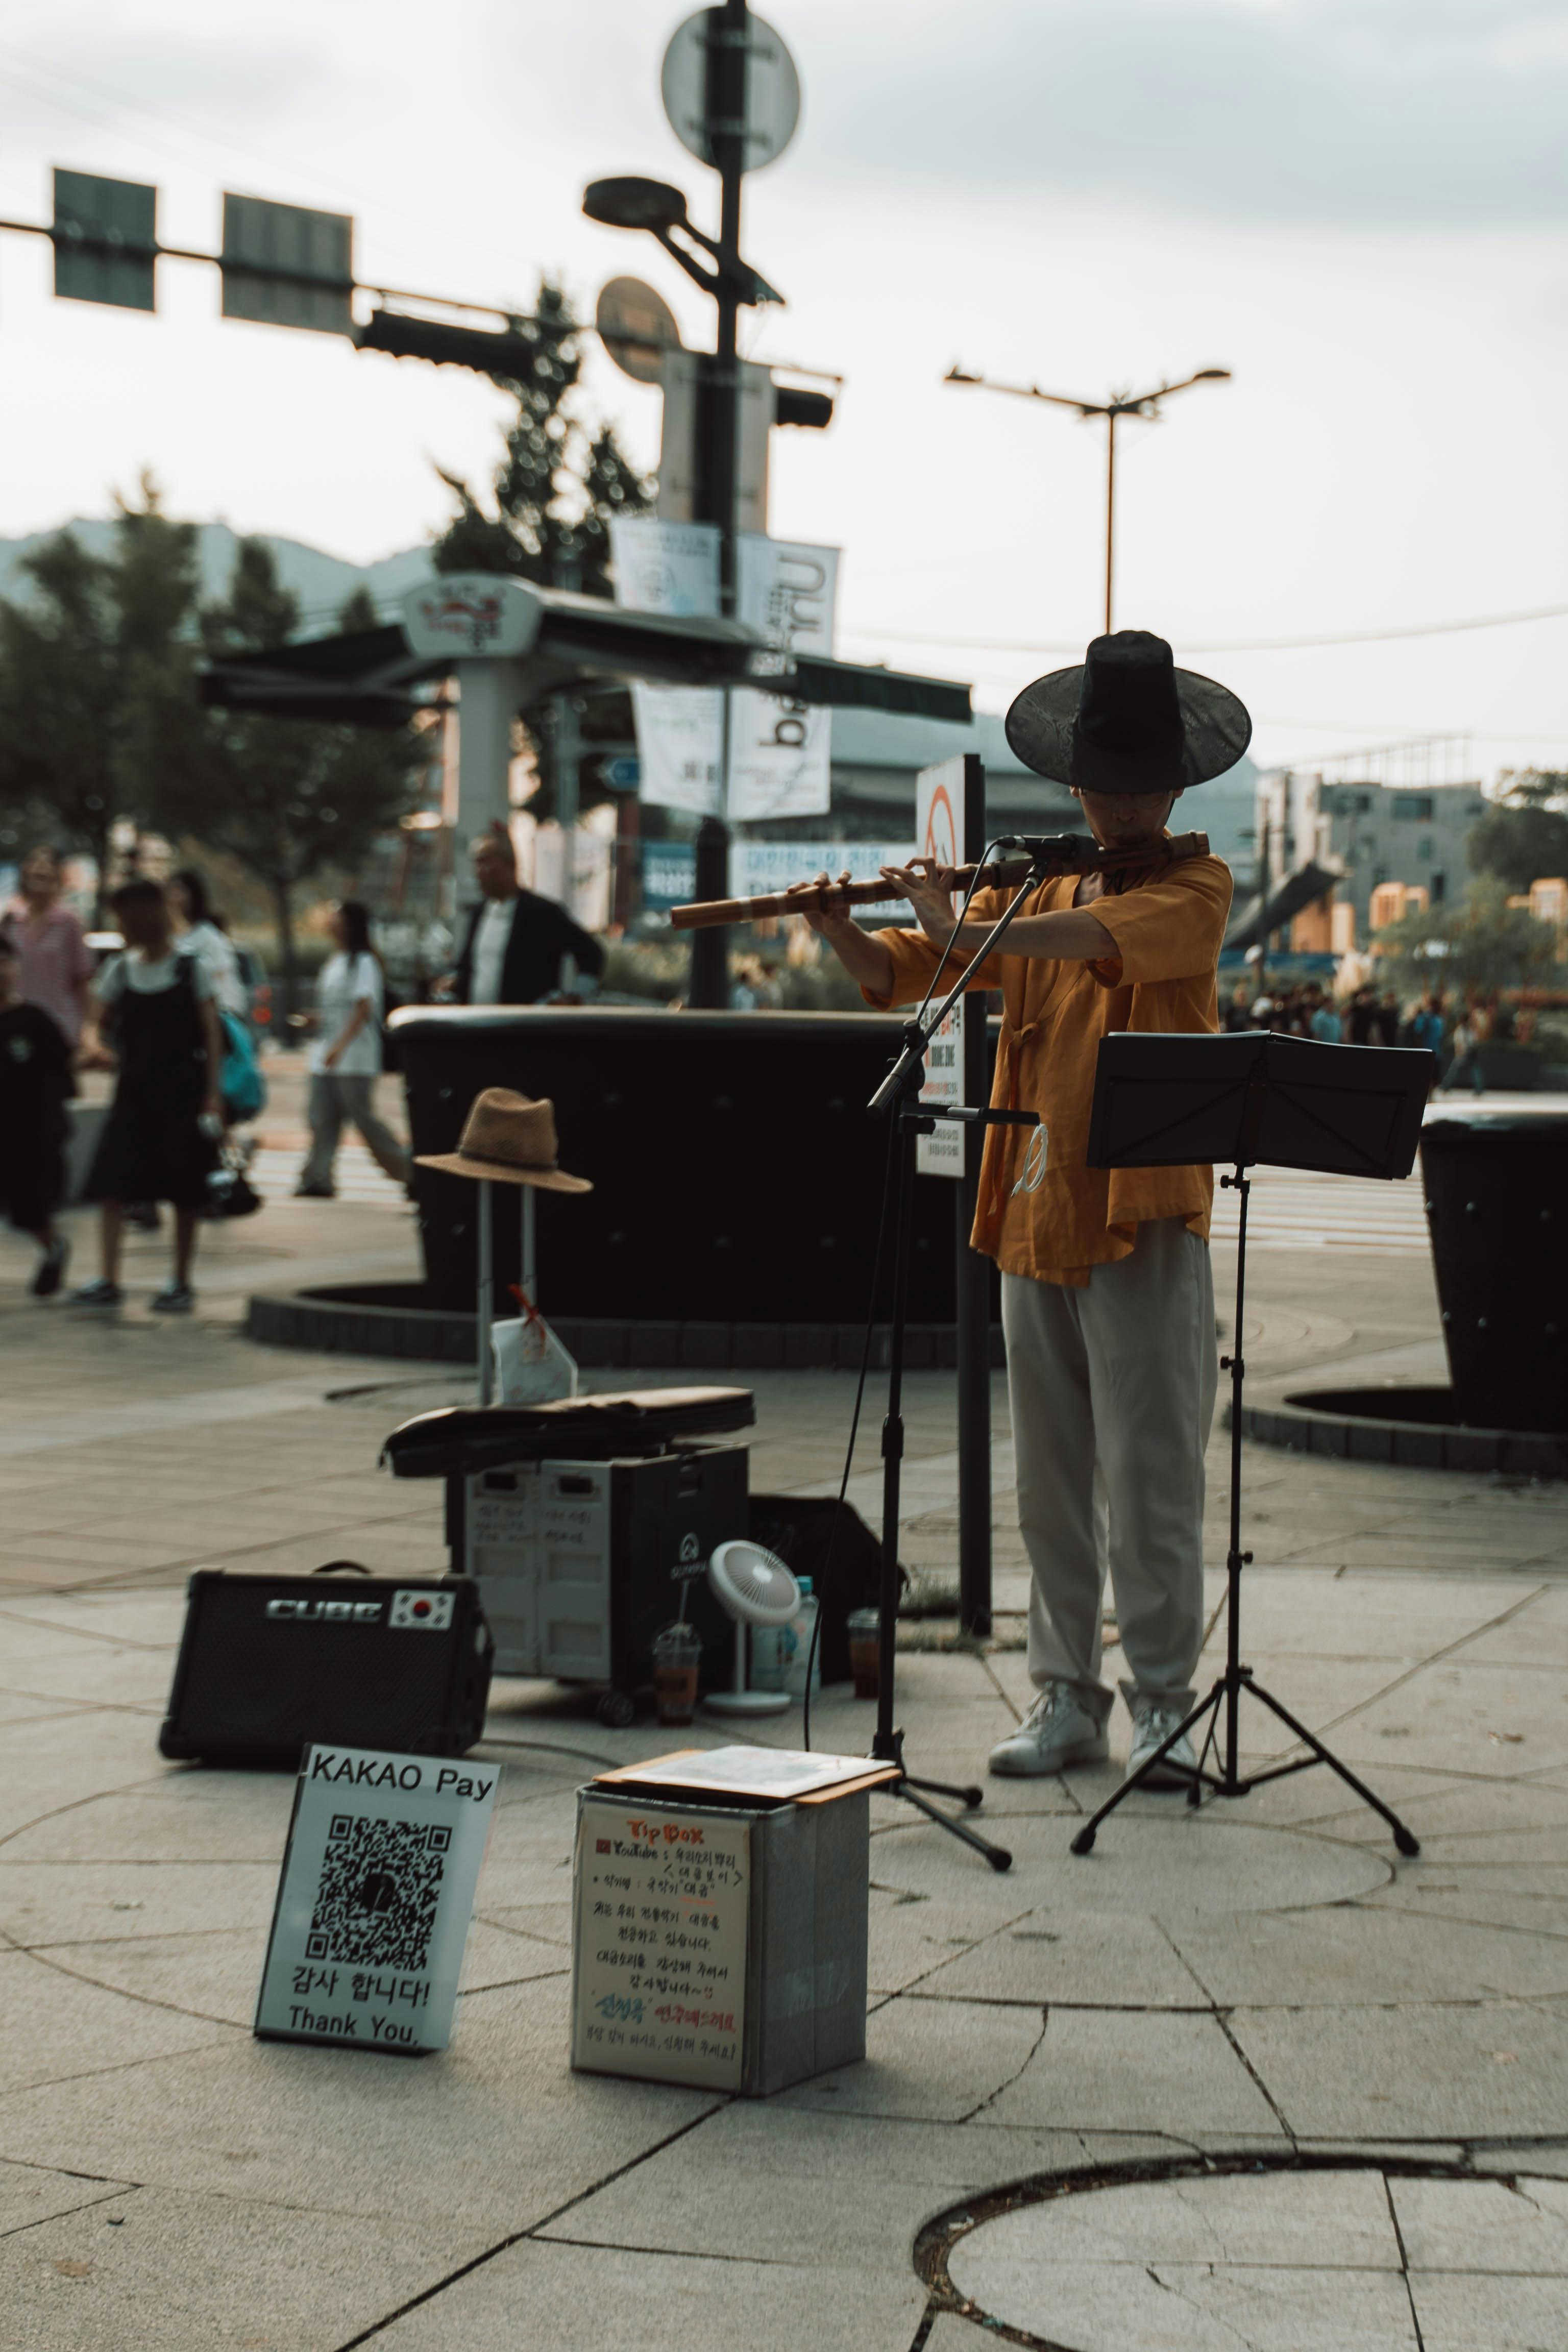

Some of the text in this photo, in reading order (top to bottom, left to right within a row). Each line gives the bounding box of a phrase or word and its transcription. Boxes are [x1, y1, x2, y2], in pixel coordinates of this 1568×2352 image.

[266, 1600, 382, 1623] CUBE
[311, 1753, 493, 1802] KAKAO Pay
[626, 1820, 705, 1845] Tip Box
[613, 1840, 658, 1860] YouTube
[289, 2006, 357, 2036] Thank
